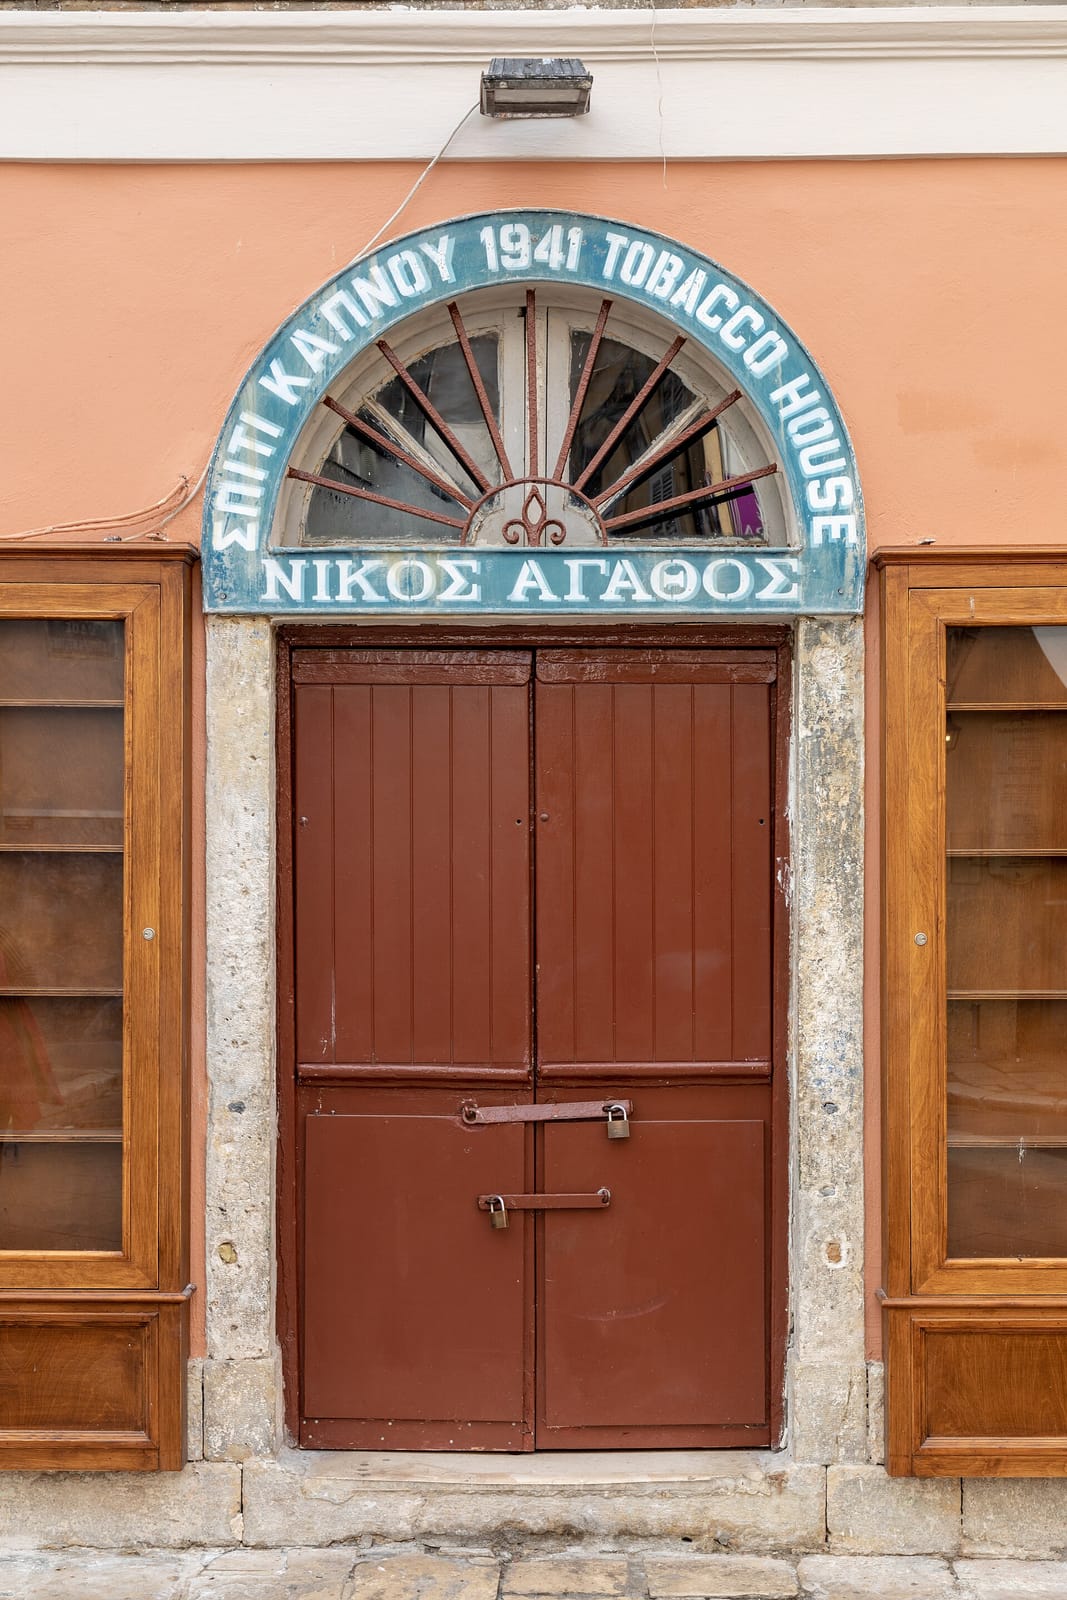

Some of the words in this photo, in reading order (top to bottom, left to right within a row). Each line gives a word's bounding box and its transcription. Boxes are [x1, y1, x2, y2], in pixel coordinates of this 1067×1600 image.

[211, 412, 284, 551] ΣΠΙΤΙ
[258, 230, 456, 406] ΚΑΠΝΟΥ
[480, 222, 584, 273] 1941
[602, 231, 788, 379] TOBACCO
[769, 373, 857, 546] HOUSE
[260, 558, 482, 603] ΝΙΚΟΣ
[507, 558, 801, 603] ΑΓΑΘΟΣ
